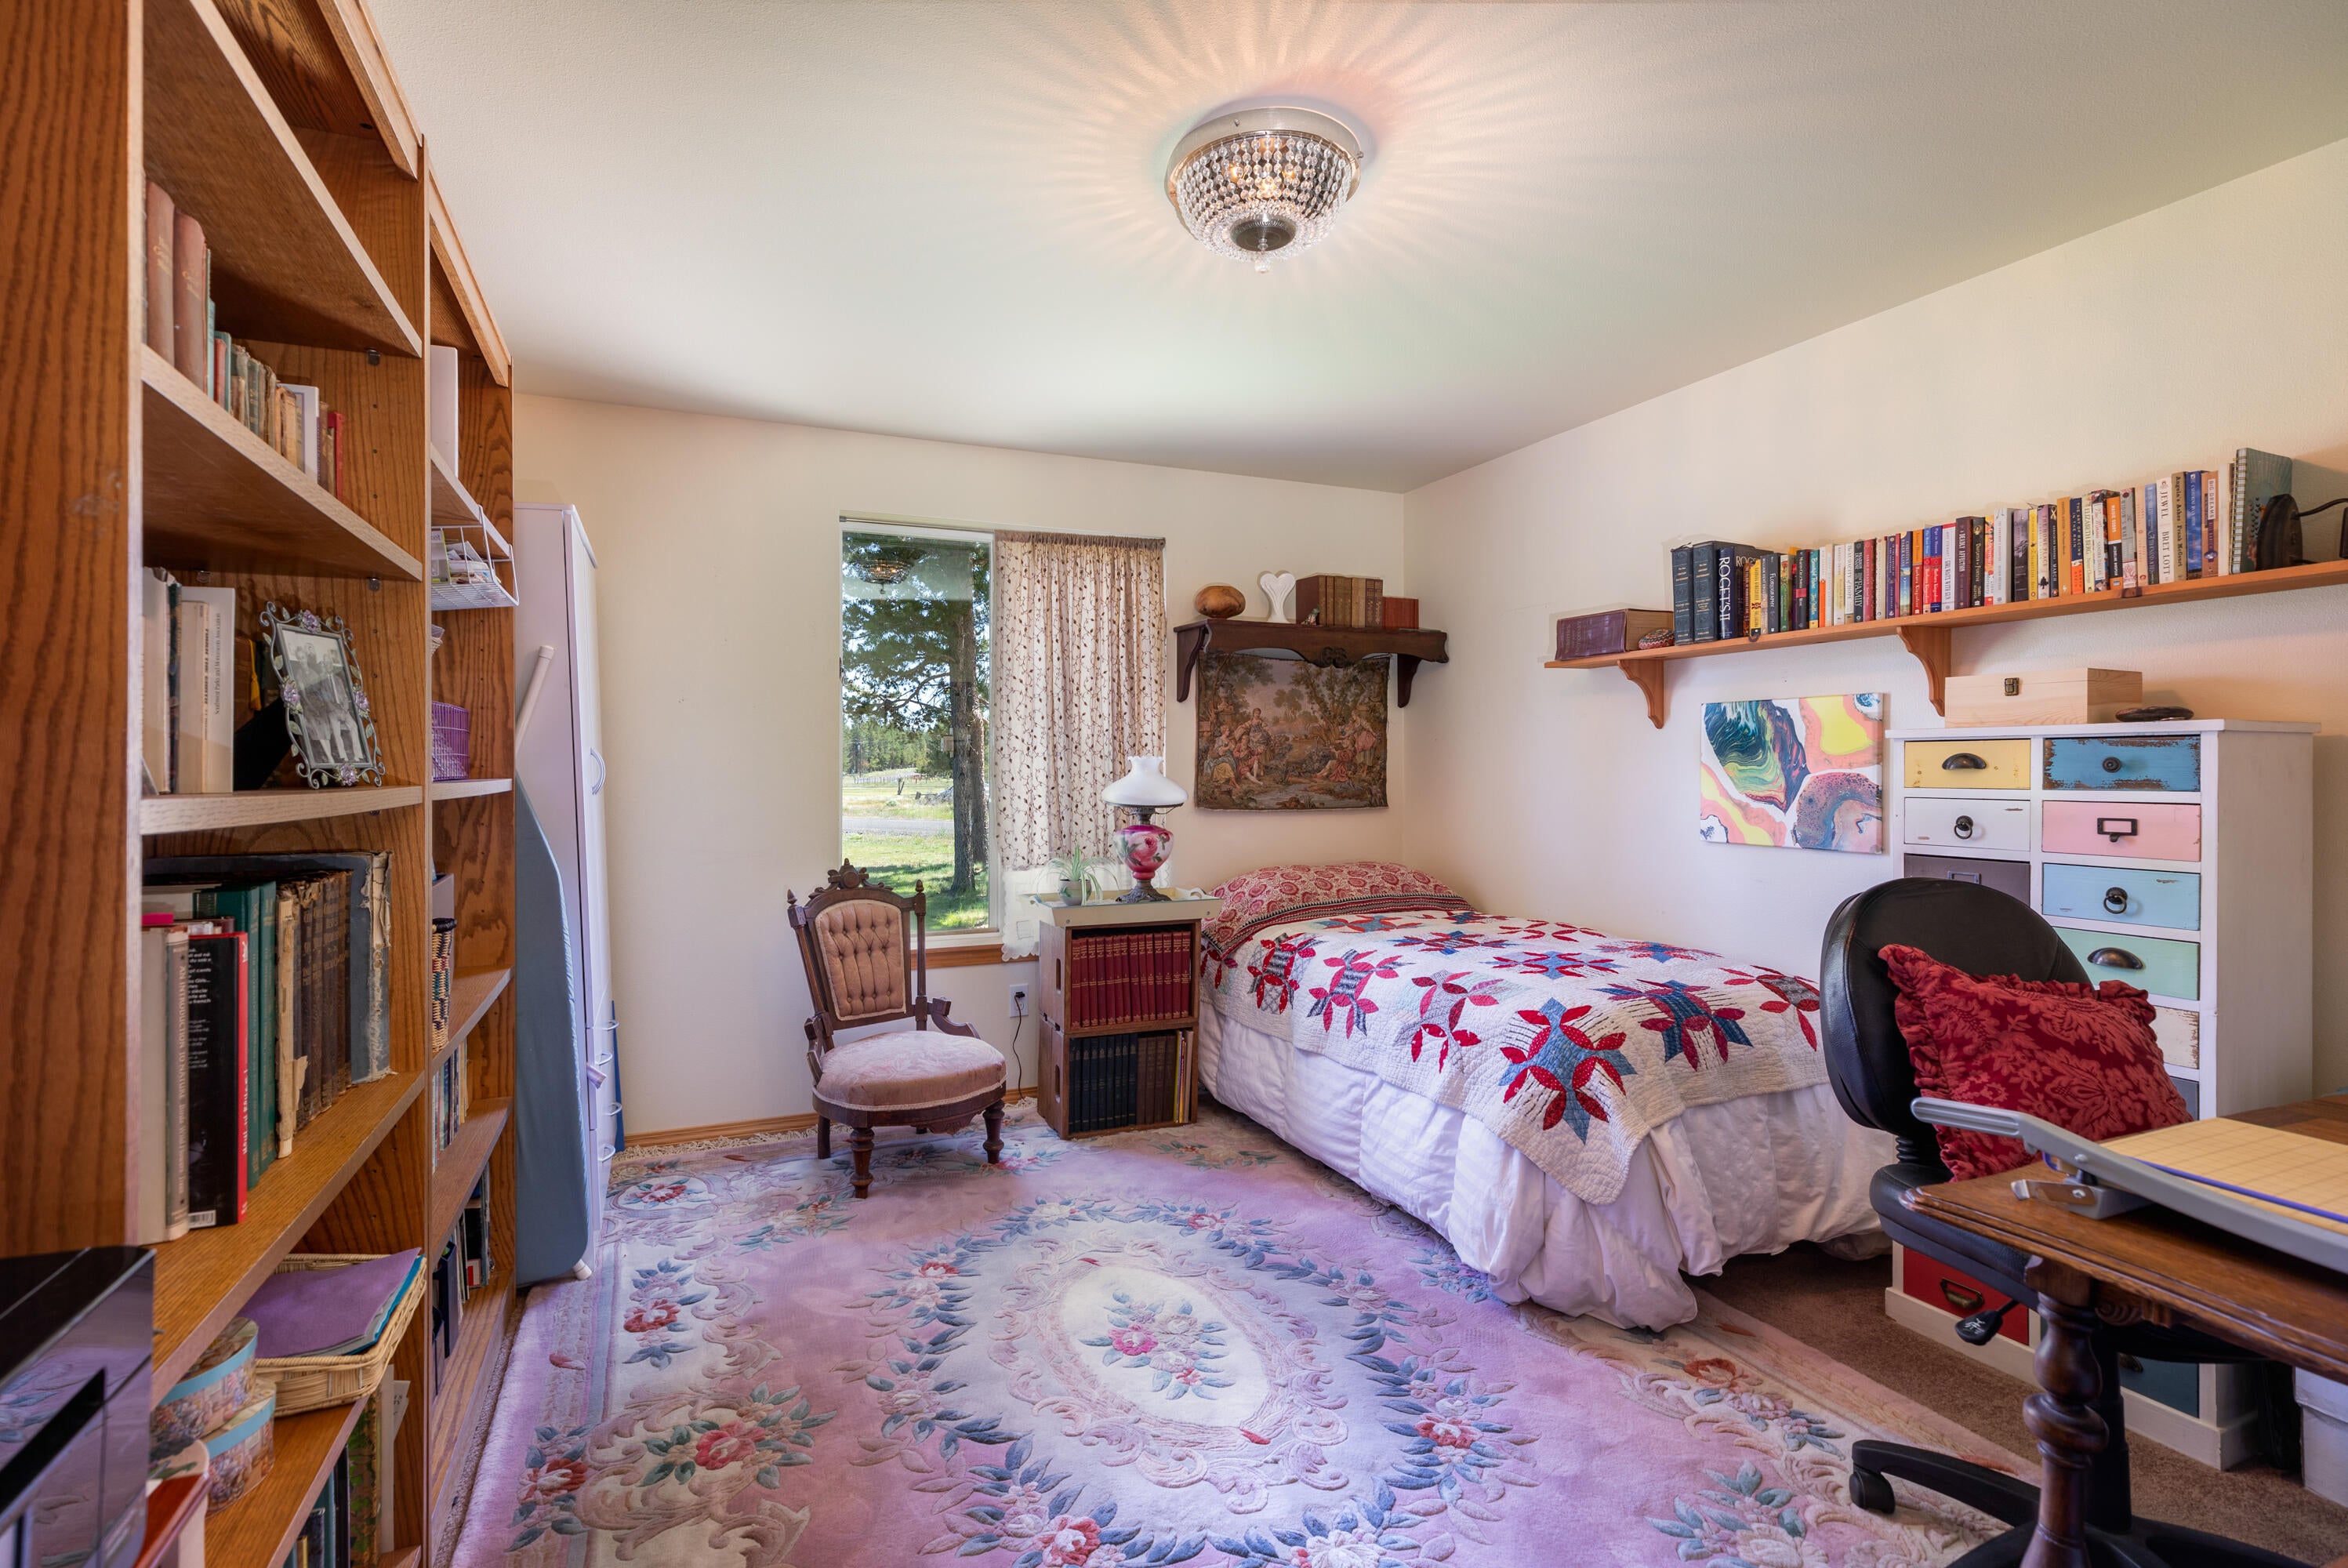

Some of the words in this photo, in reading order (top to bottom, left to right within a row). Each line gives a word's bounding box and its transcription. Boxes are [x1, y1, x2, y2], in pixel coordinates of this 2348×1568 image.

[2160, 491, 2168, 519] JEWEL
[2161, 531, 2170, 552] BRET
[1718, 557, 1731, 612] ROGET'S
[1718, 613, 1731, 622] II
[179, 965, 186, 980] AN
[179, 1051, 186, 1061] TO
